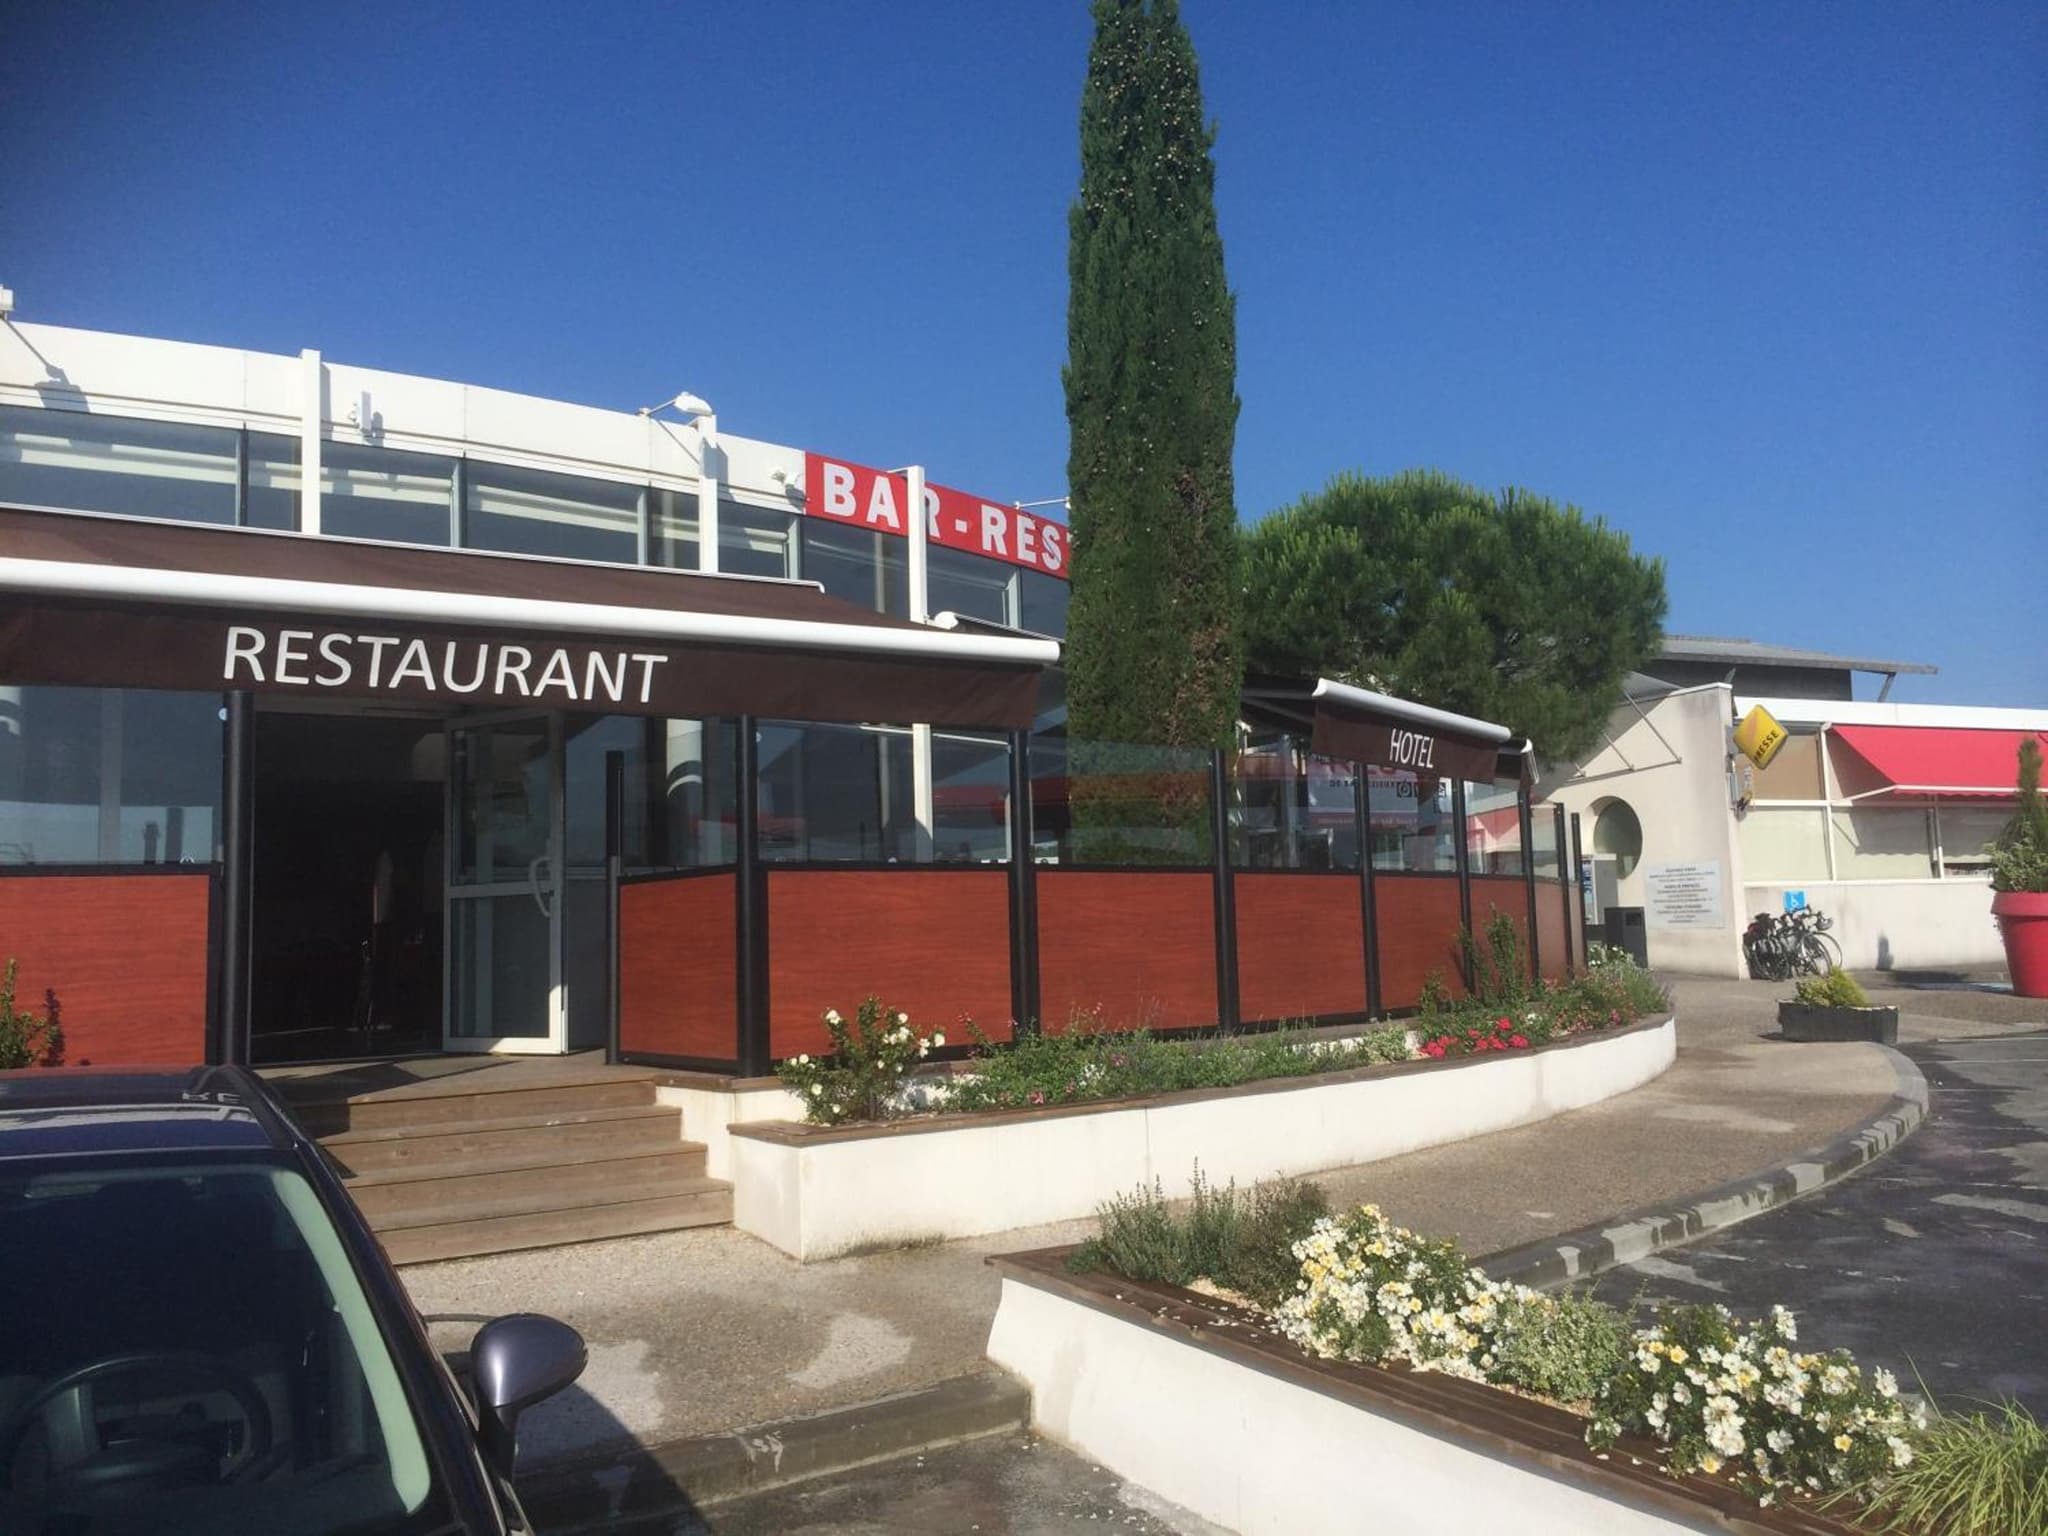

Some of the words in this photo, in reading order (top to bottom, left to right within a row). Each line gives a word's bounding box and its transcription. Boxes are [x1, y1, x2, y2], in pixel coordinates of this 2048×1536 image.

[980, 503, 1072, 571] RES
[223, 626, 669, 704] RESTAURANT
[1388, 728, 1435, 769] HOTEL
[1753, 729, 1780, 763] PRESSE
